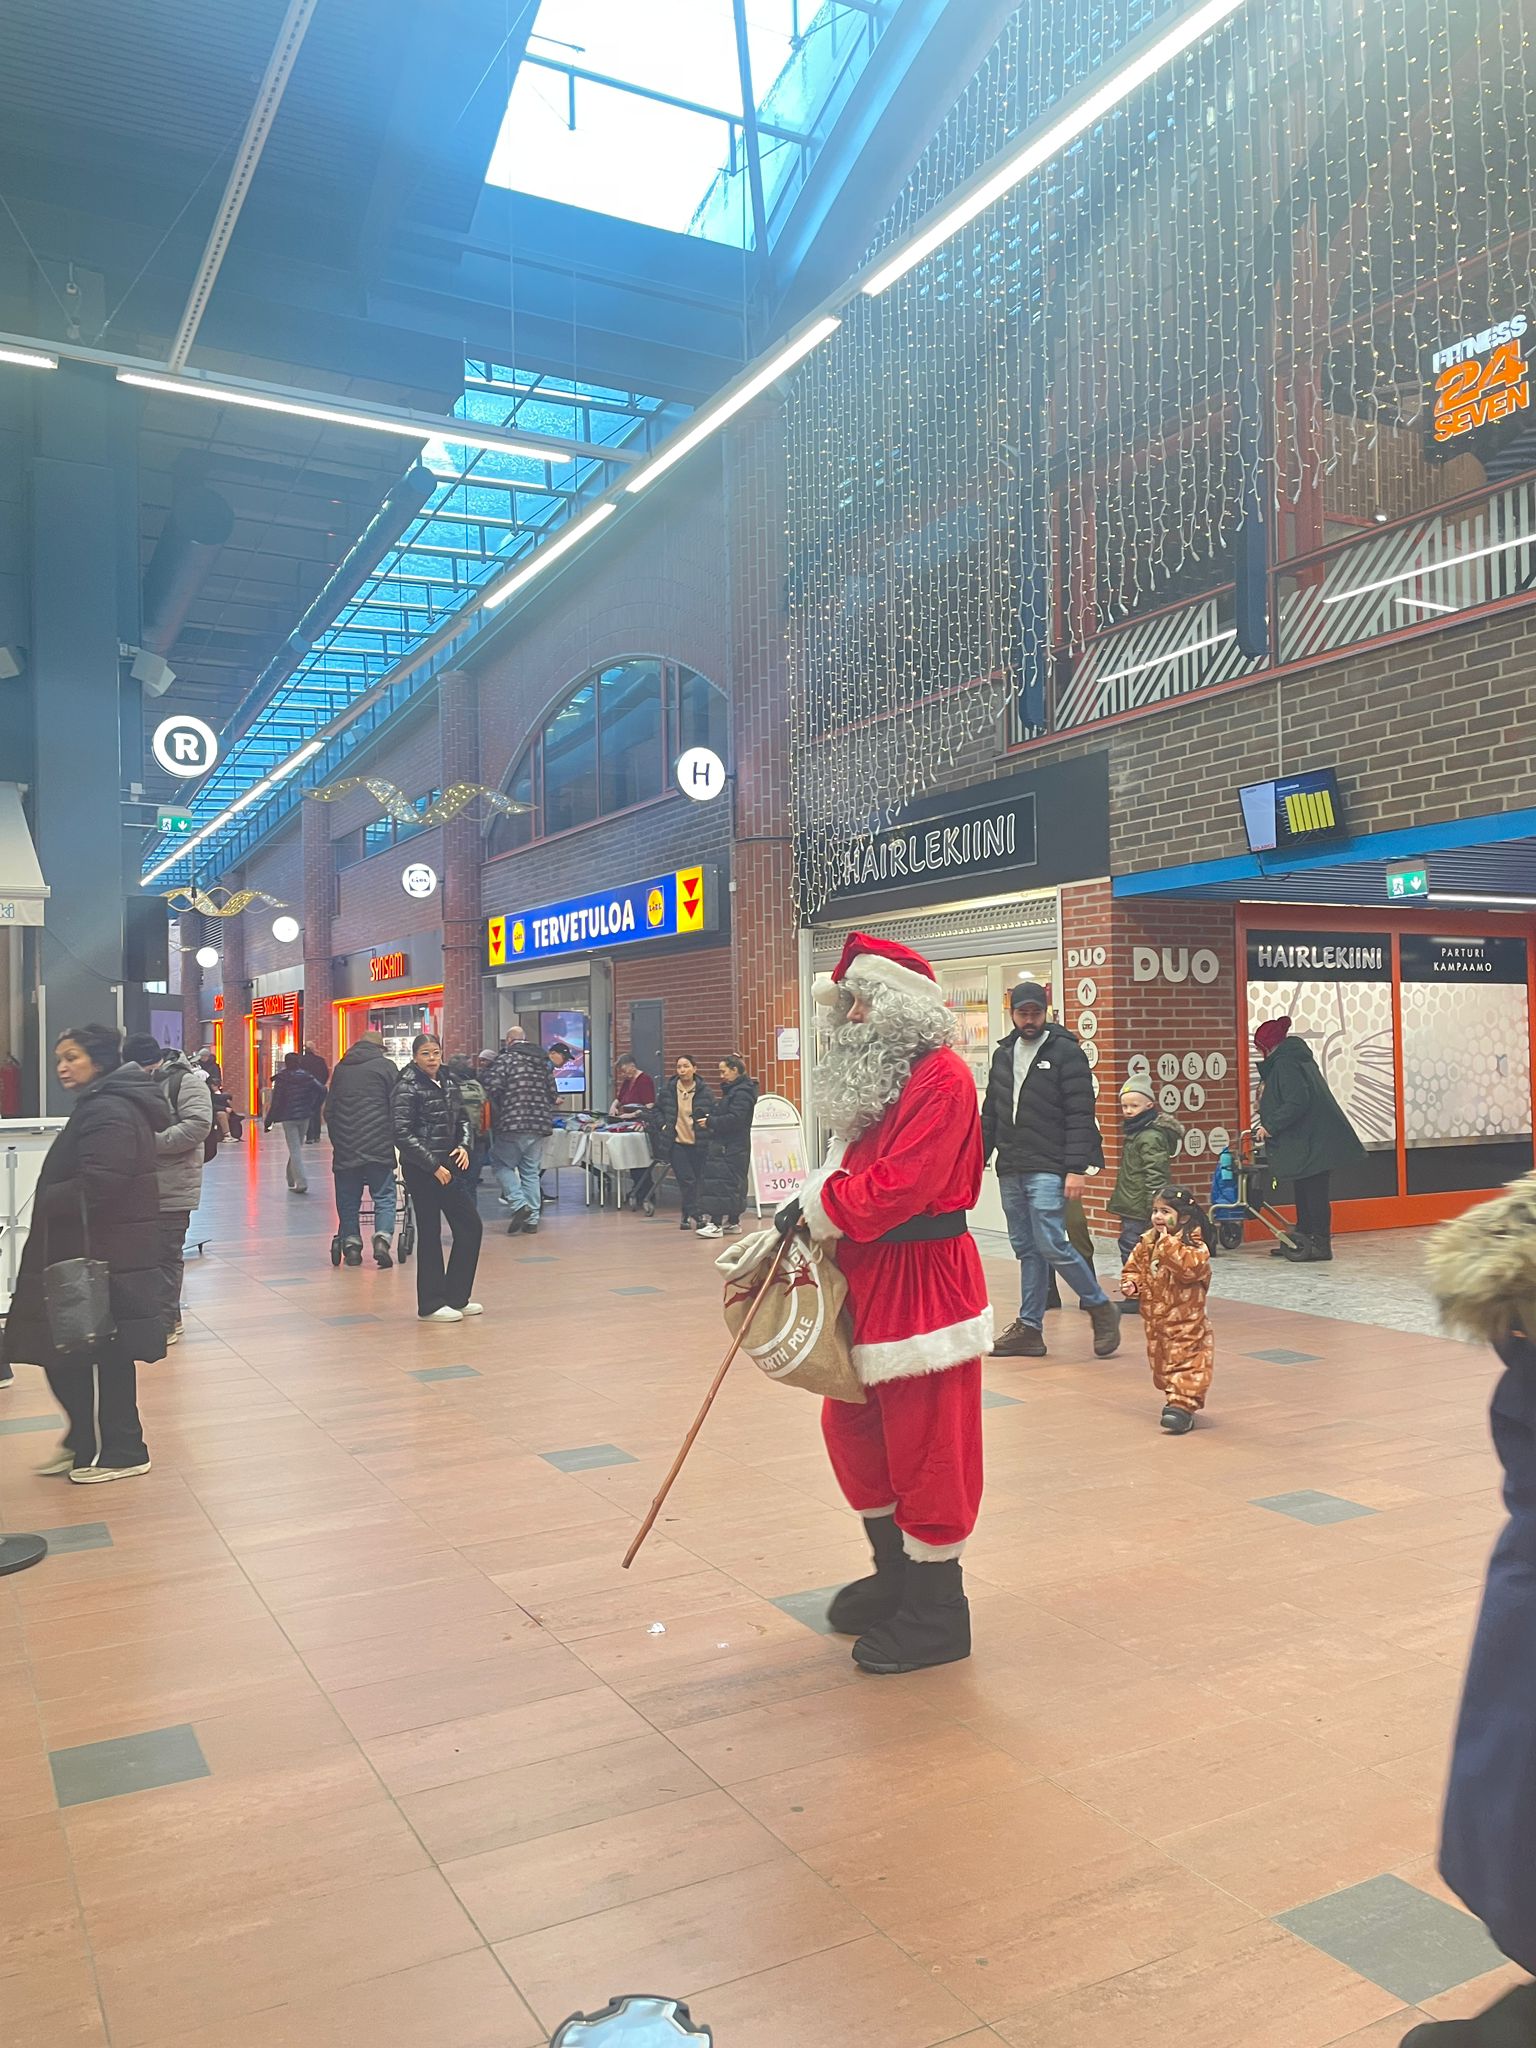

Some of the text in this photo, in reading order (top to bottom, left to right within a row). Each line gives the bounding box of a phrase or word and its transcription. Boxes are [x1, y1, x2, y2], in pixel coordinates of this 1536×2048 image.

[1433, 315, 1528, 373] FITNESS
[1434, 339, 1528, 417] 24
[1434, 381, 1529, 442] SEVEN
[693, 762, 710, 786] H
[843, 813, 1016, 887] HAIRLEKIINI
[532, 900, 635, 948] TERVETULOA
[1067, 947, 1106, 967] DUO
[1133, 947, 1219, 984] DUO
[1258, 945, 1382, 969] HAIRLEKIINI
[1433, 962, 1492, 972] KAMPAAMO
[1441, 948, 1484, 958] PARTURI
[765, 1177, 799, 1190] -30%
[757, 1316, 813, 1371] NORTH POLE
